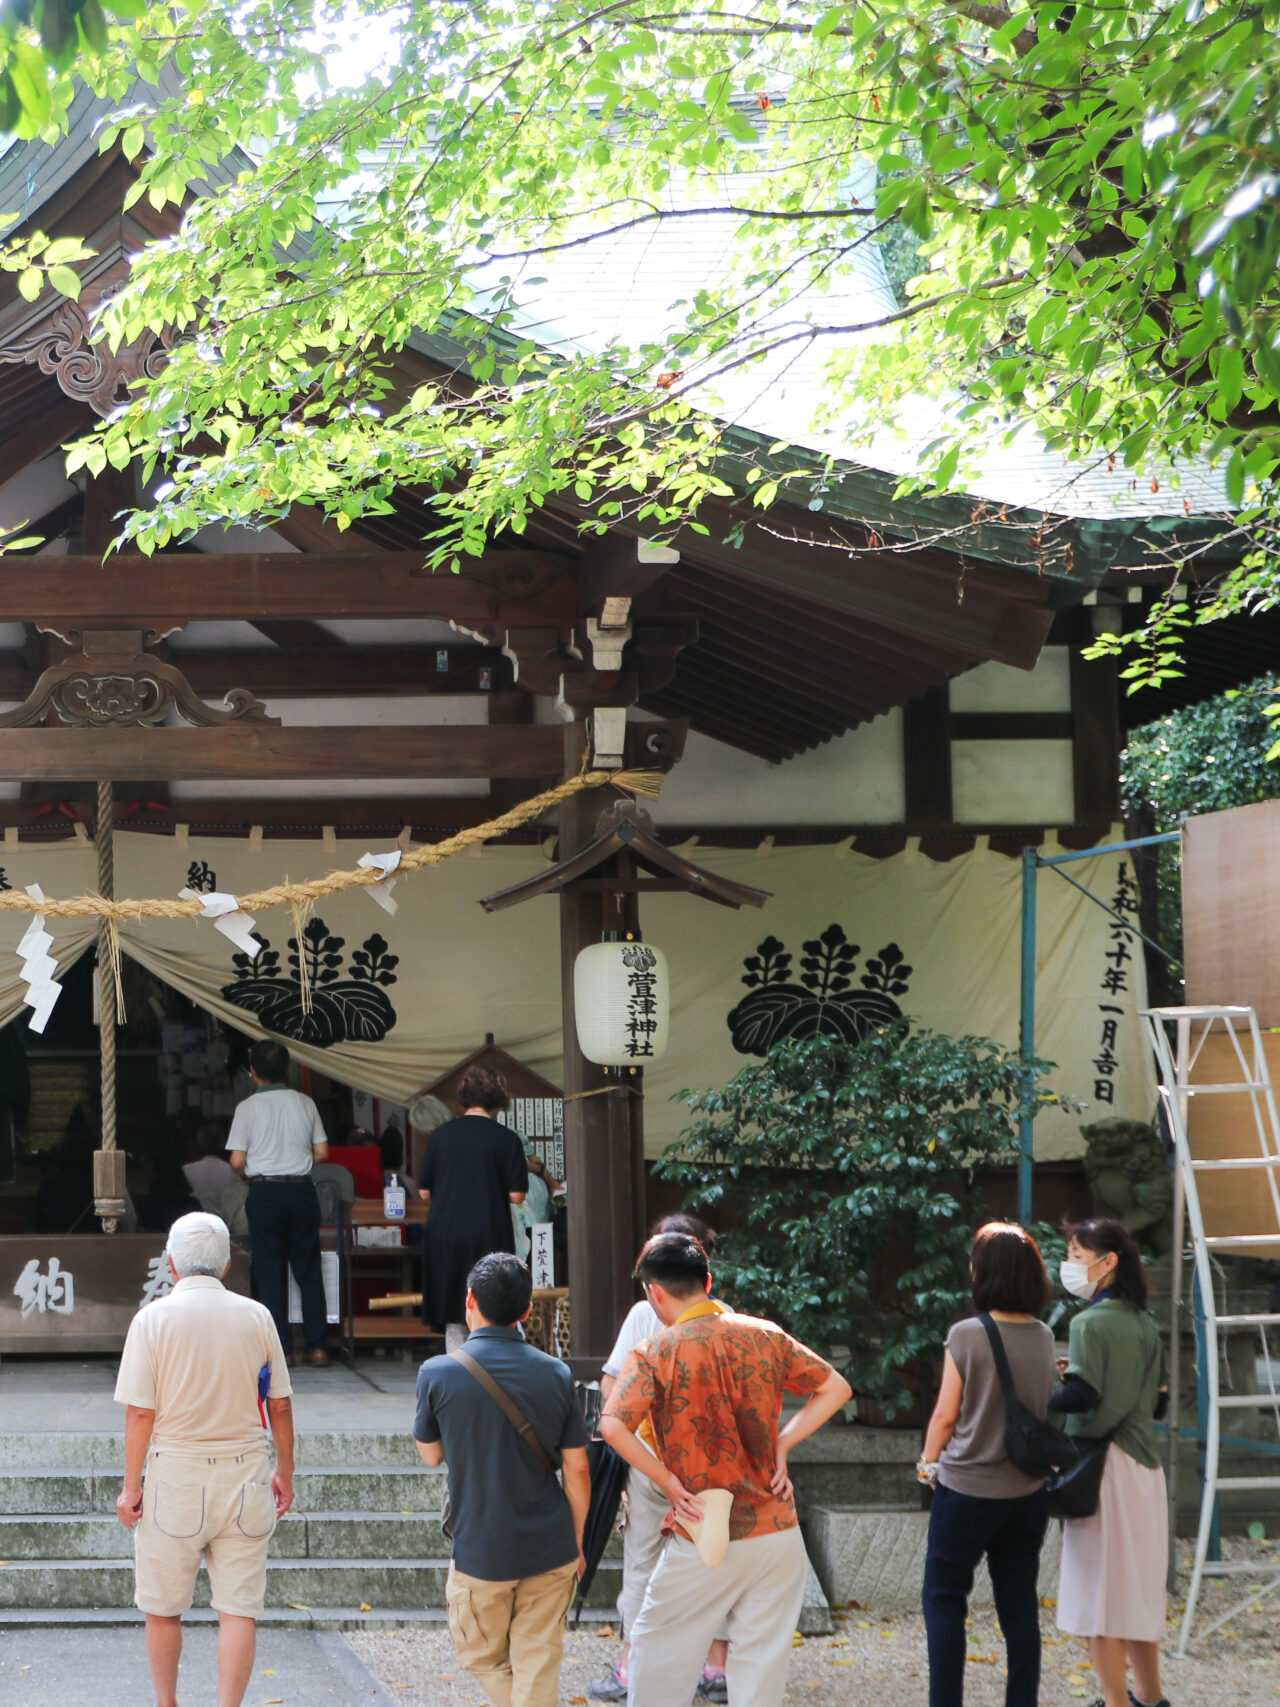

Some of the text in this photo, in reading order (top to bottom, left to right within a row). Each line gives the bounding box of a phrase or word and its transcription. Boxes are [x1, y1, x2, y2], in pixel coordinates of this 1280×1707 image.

[185, 861, 217, 892] 納
[623, 971, 658, 1058] 萱津神社
[13, 1257, 75, 1320] 納
